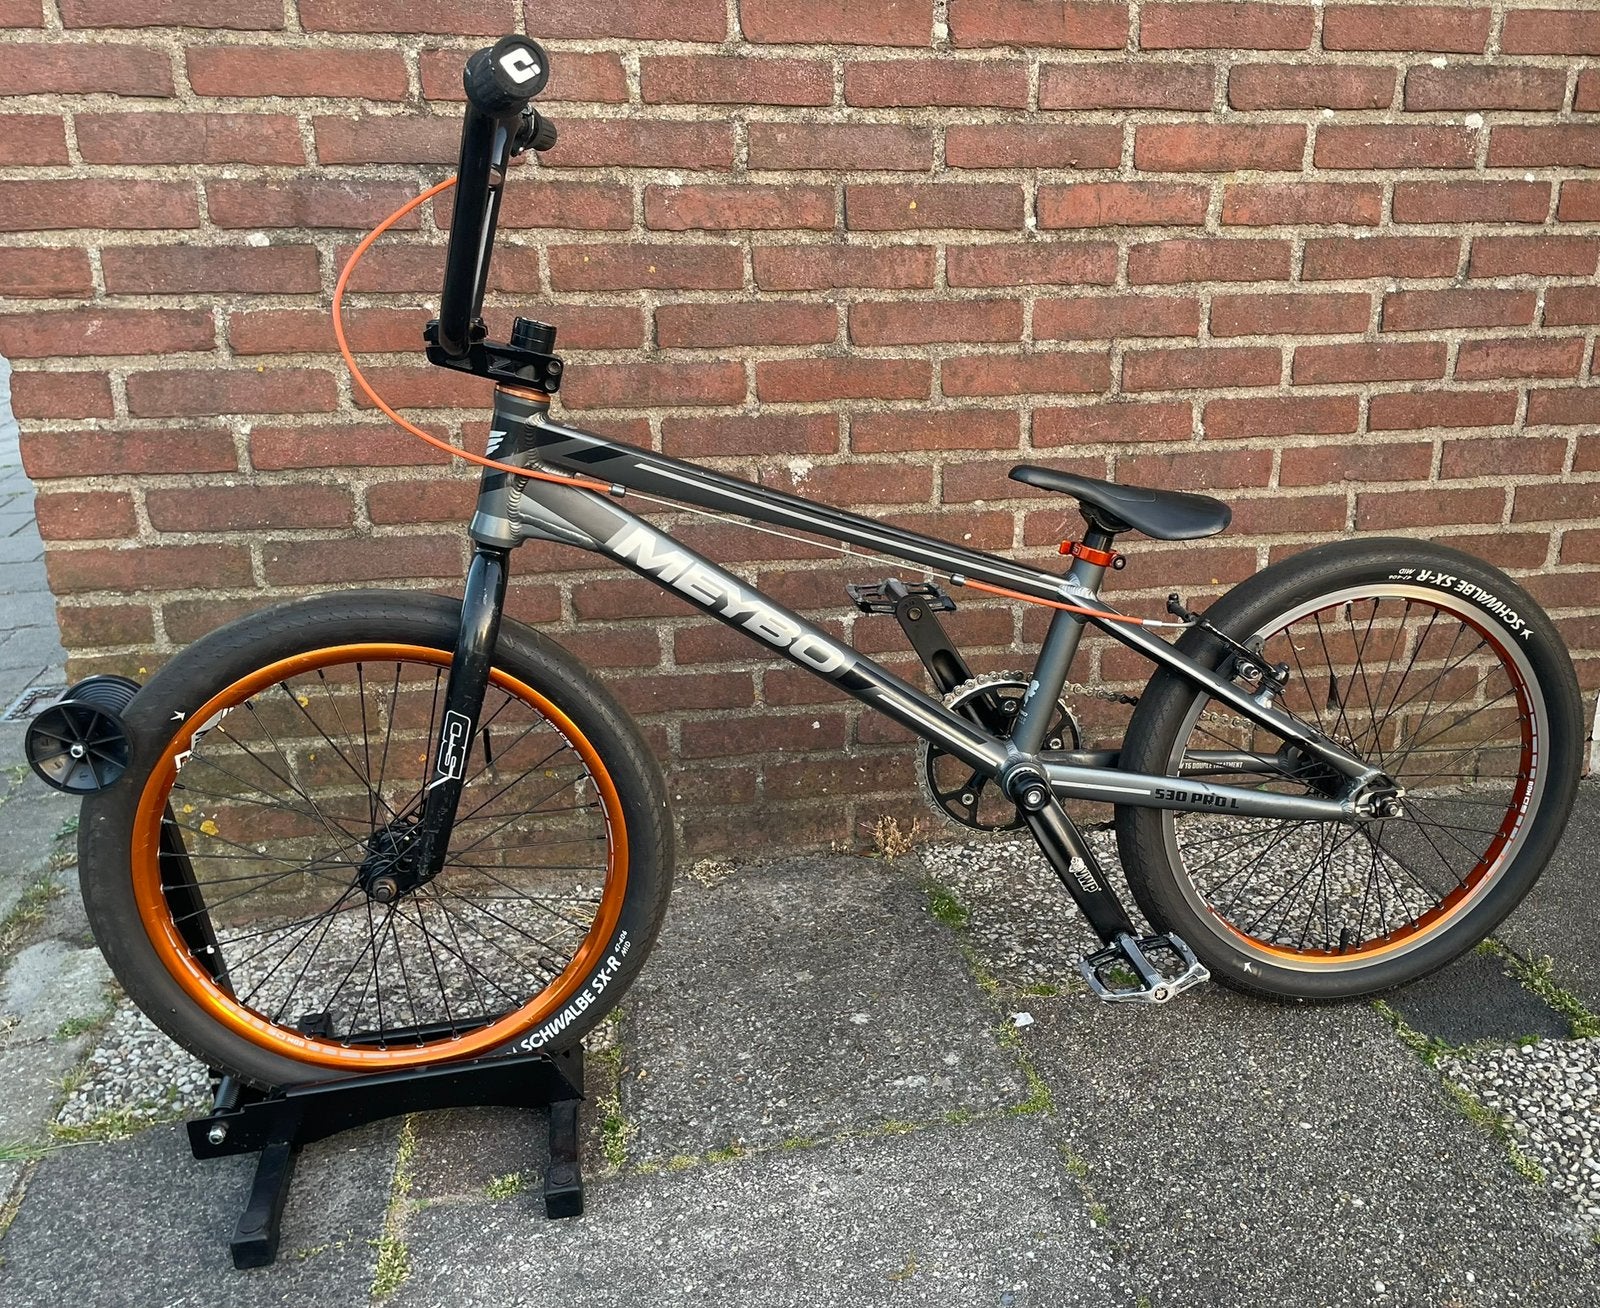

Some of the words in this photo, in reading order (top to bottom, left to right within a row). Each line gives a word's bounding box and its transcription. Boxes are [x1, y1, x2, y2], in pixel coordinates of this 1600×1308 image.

[1416, 568, 1458, 588] SX-R
[612, 526, 846, 674] MEYBO
[1453, 579, 1527, 631] SCHWALBE
[1190, 792, 1226, 807] PRO
[1230, 797, 1240, 809] L
[621, 940, 632, 958] MID
[520, 989, 597, 1053] SCHWALBE
[591, 955, 622, 995] SX-R
